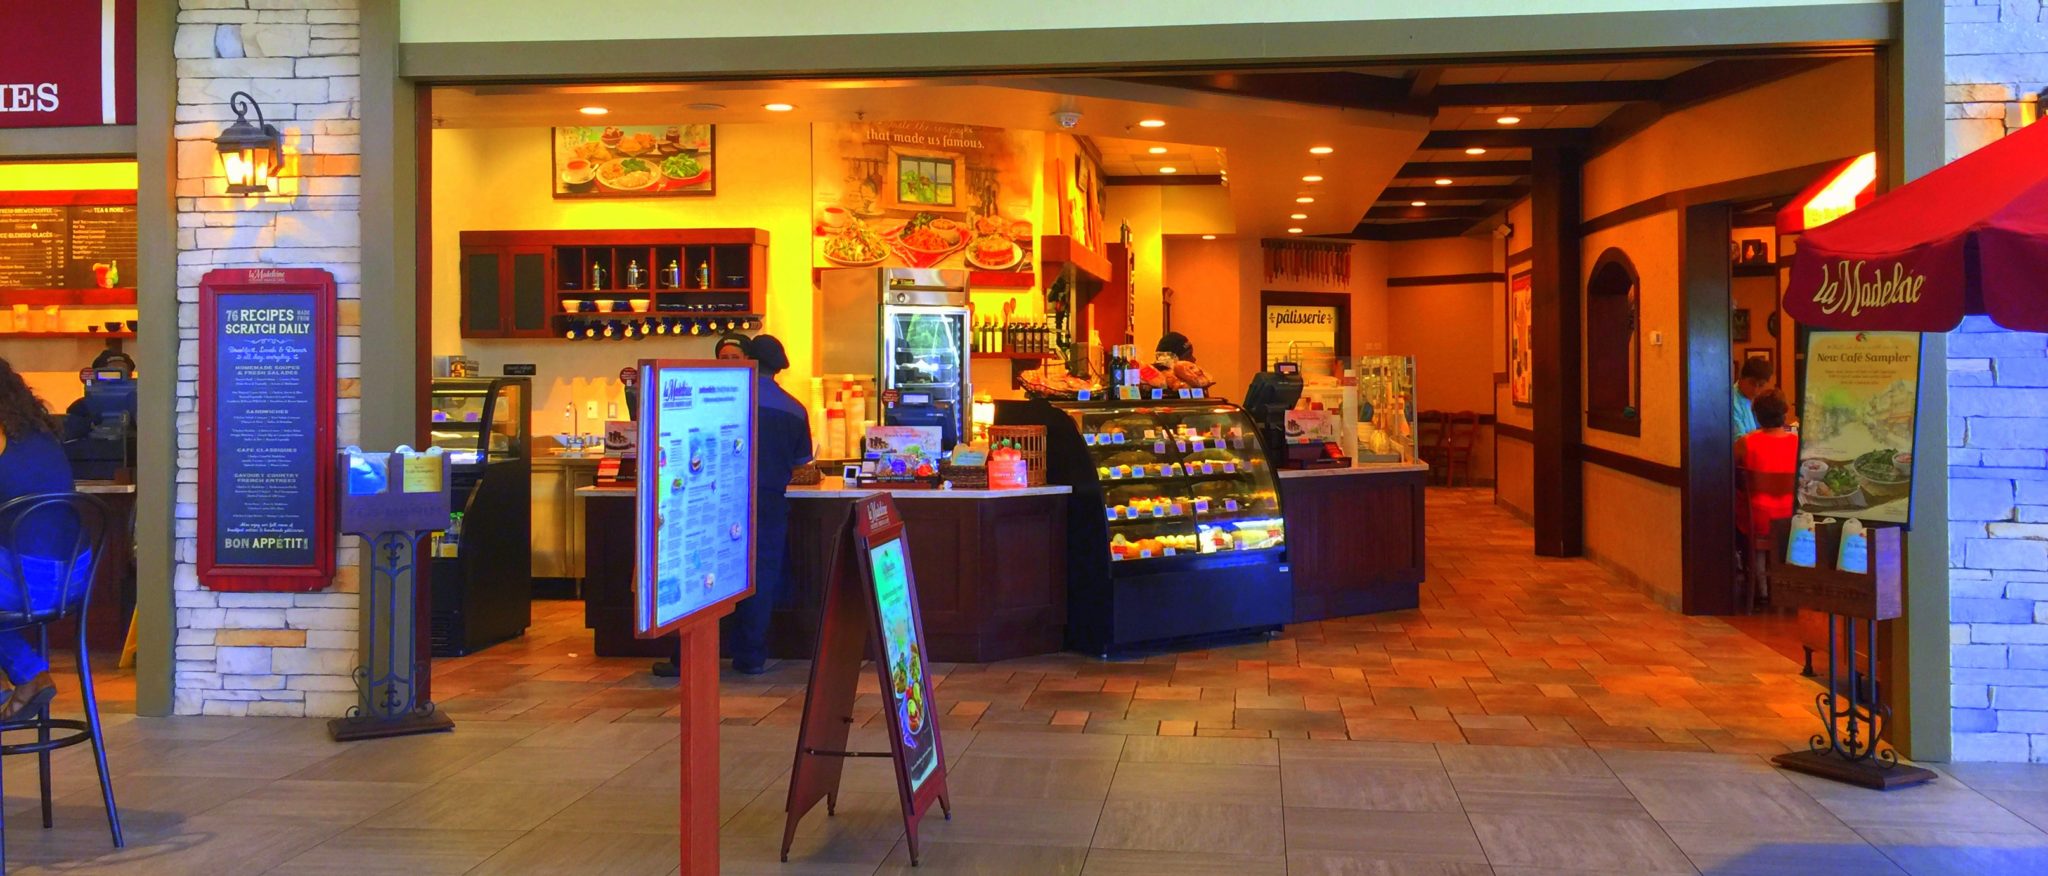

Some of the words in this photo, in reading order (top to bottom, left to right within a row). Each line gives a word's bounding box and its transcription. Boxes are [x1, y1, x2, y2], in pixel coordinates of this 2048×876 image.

[866, 128, 890, 141] that
[893, 132, 925, 143] made
[927, 136, 940, 145] us
[943, 135, 985, 149] famous.
[225, 309, 239, 322] 76
[240, 308, 294, 322] RECIPES
[1275, 309, 1326, 329] pâtisserie
[225, 323, 276, 334] SCRATCH
[279, 323, 310, 334] DAILY
[1816, 352, 1838, 363] New
[1840, 351, 1863, 364] Café
[1864, 352, 1911, 365] Sampler
[225, 537, 250, 549] BON
